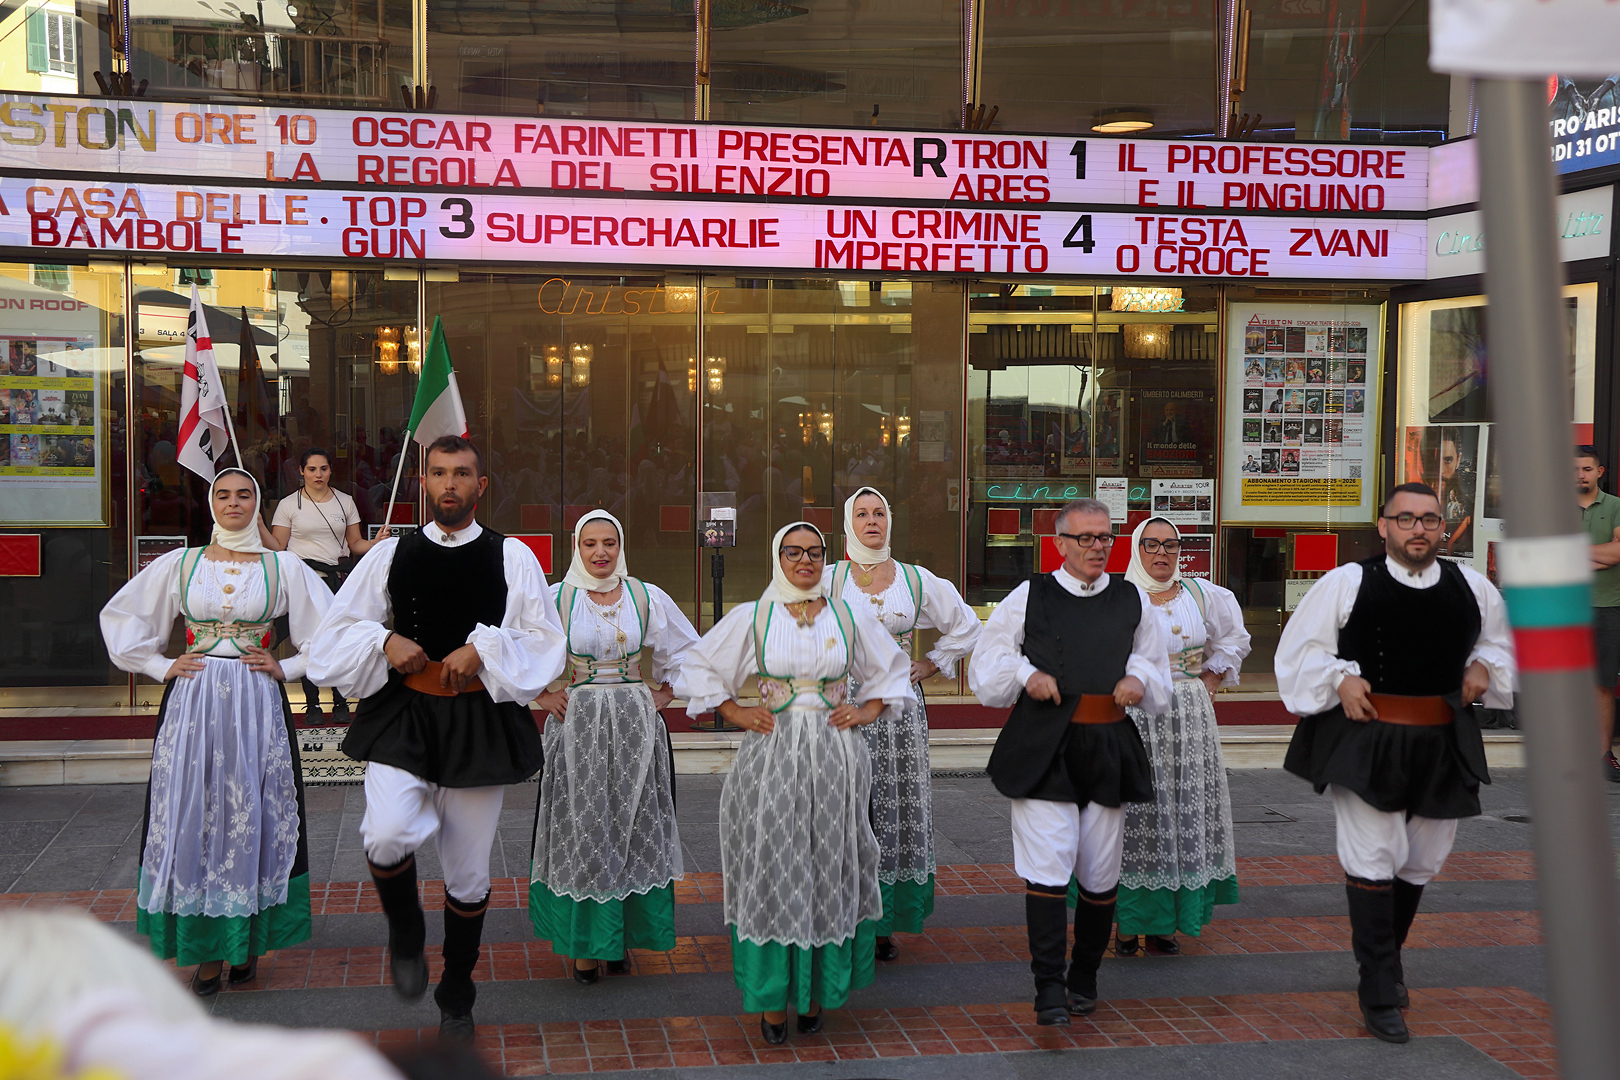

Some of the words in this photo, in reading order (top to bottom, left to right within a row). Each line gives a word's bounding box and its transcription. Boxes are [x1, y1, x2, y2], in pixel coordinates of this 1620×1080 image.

[0, 102, 156, 152] STON
[1584, 106, 1620, 131] ARI
[174, 112, 257, 145] ORE
[274, 114, 316, 146] 10
[352, 117, 492, 152] OSCAR
[514, 124, 697, 158] FARINETTI
[718, 130, 911, 167] PRESENTA
[952, 139, 1048, 170] TRON
[1576, 138, 1592, 157] 31
[1596, 131, 1620, 152] OT
[914, 137, 948, 178] R
[1070, 140, 1087, 180] 1
[1118, 144, 1148, 172] IL
[1168, 144, 1406, 178] PROFESSORE
[266, 151, 322, 183] LA
[357, 154, 522, 188] REGOLA
[550, 160, 625, 192] DEL
[650, 163, 830, 198] SILENZIO
[950, 174, 1050, 203] ARES
[26, 186, 147, 220] CASA
[1138, 179, 1159, 208] E
[1178, 180, 1206, 210] IL
[1223, 182, 1384, 212] PINGUINO
[342, 196, 427, 228] TOP
[438, 197, 475, 239] 3
[826, 210, 876, 238] UN
[892, 210, 1041, 243] CRIMINE
[30, 214, 244, 254] BAMBOLE
[342, 227, 426, 259] GUN
[486, 212, 780, 248] SUPERCHARLIE
[1062, 214, 1096, 254] 4
[1135, 216, 1248, 247] TESTA
[1289, 228, 1388, 258] ZVANI
[814, 239, 1048, 273] IMPERFETTO
[1116, 244, 1140, 272] O
[1154, 246, 1270, 276] CROCE
[30, 299, 88, 311] ROOF
[538, 278, 725, 314] Ariston
[1126, 291, 1186, 312] Ritz
[1248, 314, 1293, 326] ARISTON
[1146, 450, 1197, 458] EMOZIONI
[1178, 442, 1197, 450] delle
[1152, 466, 1194, 476] ARISTON
[1178, 554, 1196, 562] orte
